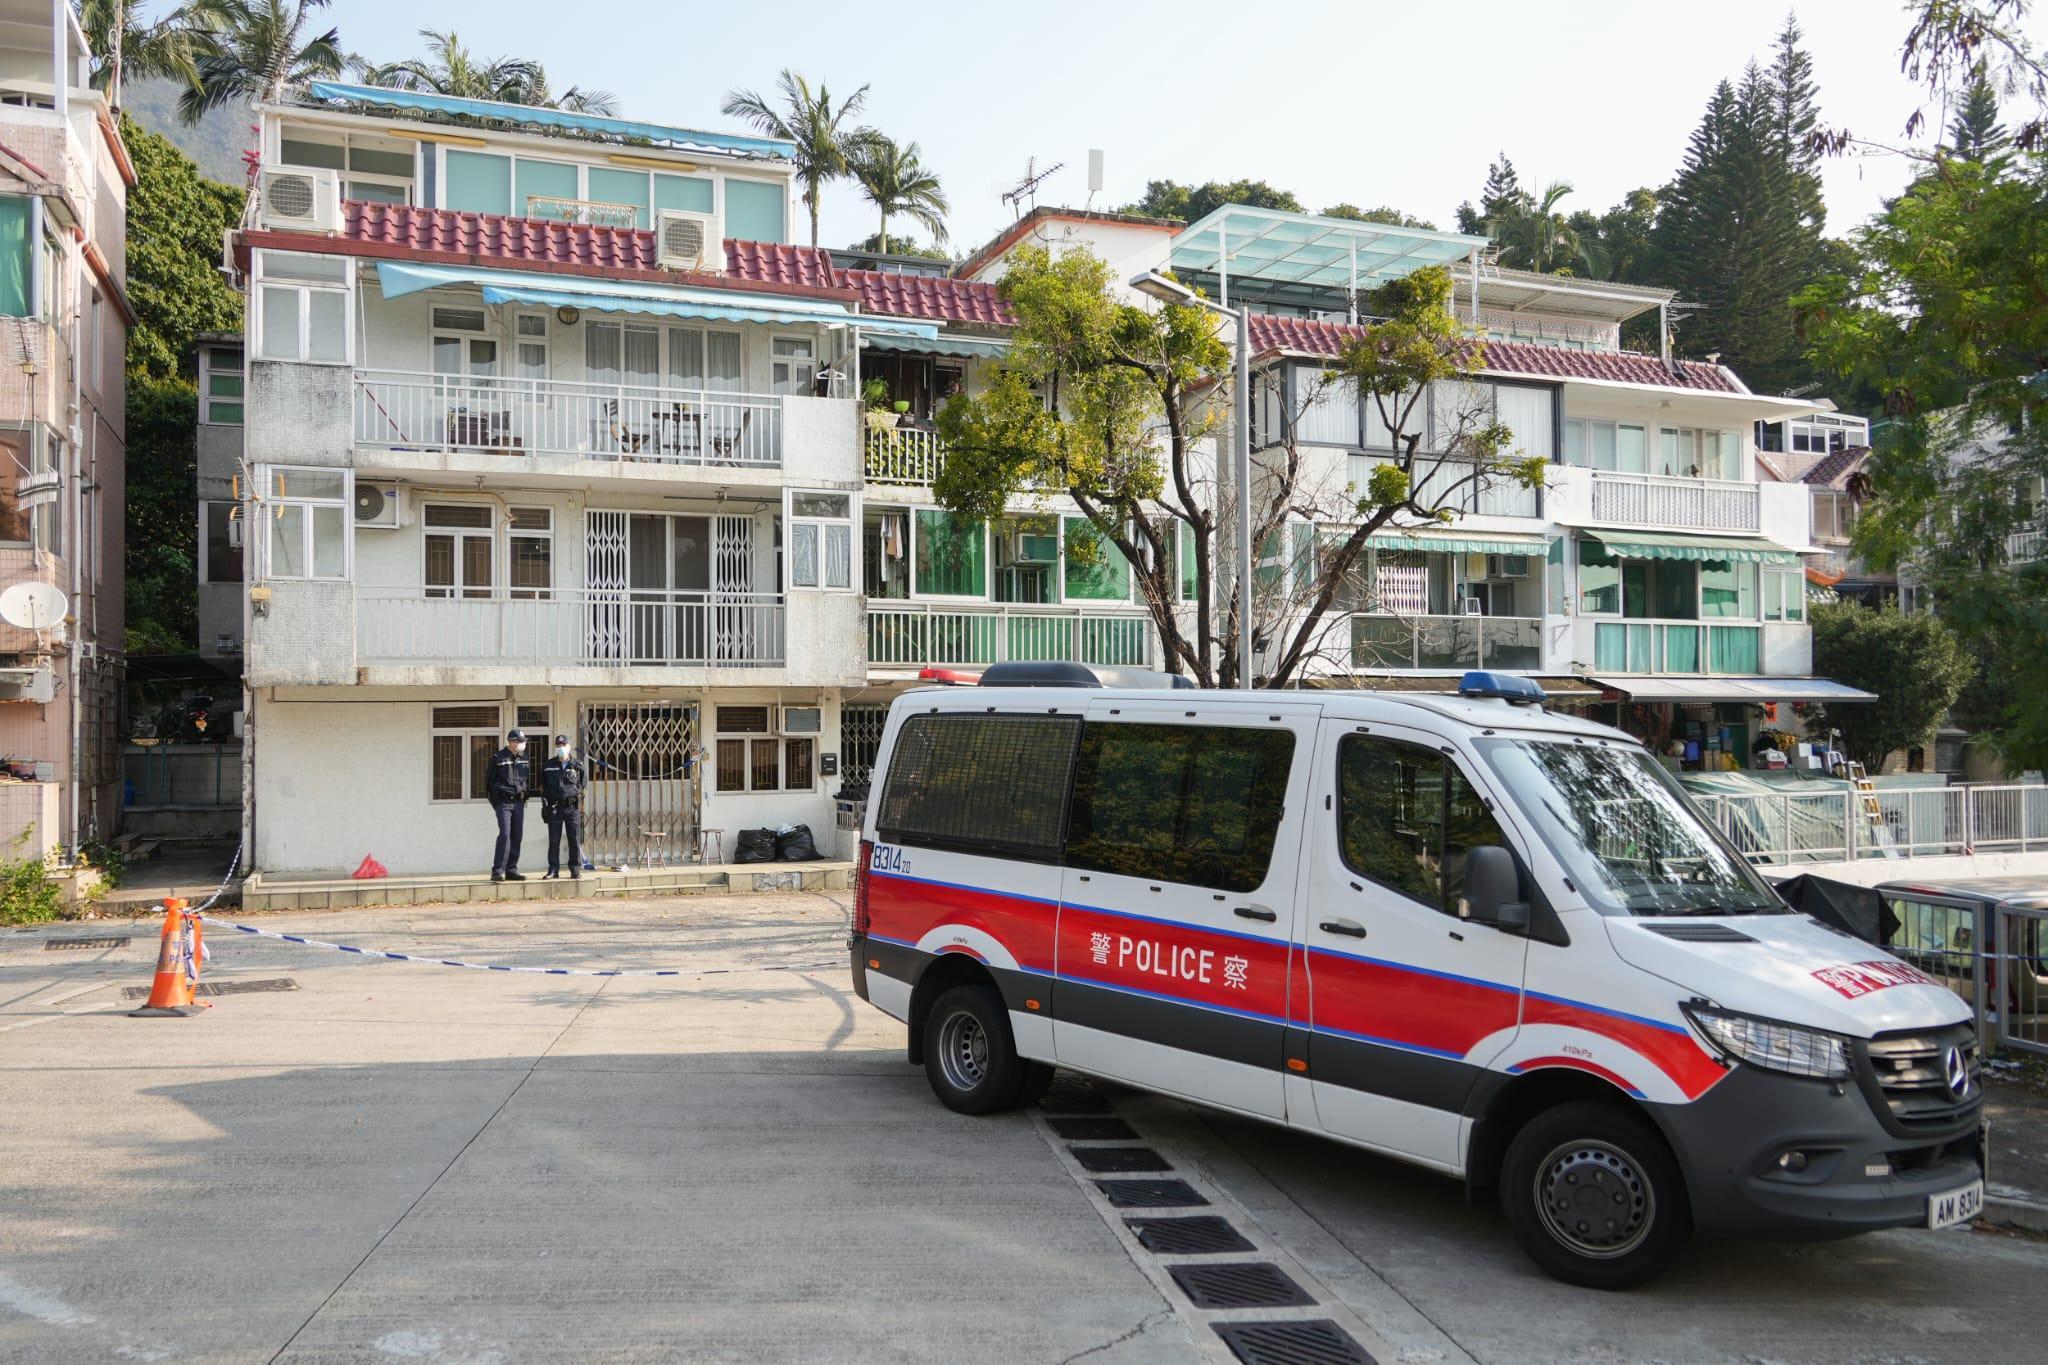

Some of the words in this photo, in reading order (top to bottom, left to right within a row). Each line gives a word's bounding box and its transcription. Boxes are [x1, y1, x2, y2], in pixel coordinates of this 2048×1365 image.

[873, 845, 902, 872] 8314
[901, 860, 911, 873] 20
[1090, 931, 1112, 965] 警
[1118, 936, 1215, 985] POLICE
[1223, 954, 1249, 990] 察
[1937, 1197, 1955, 1225] AM
[1959, 1184, 1980, 1217] 8314
